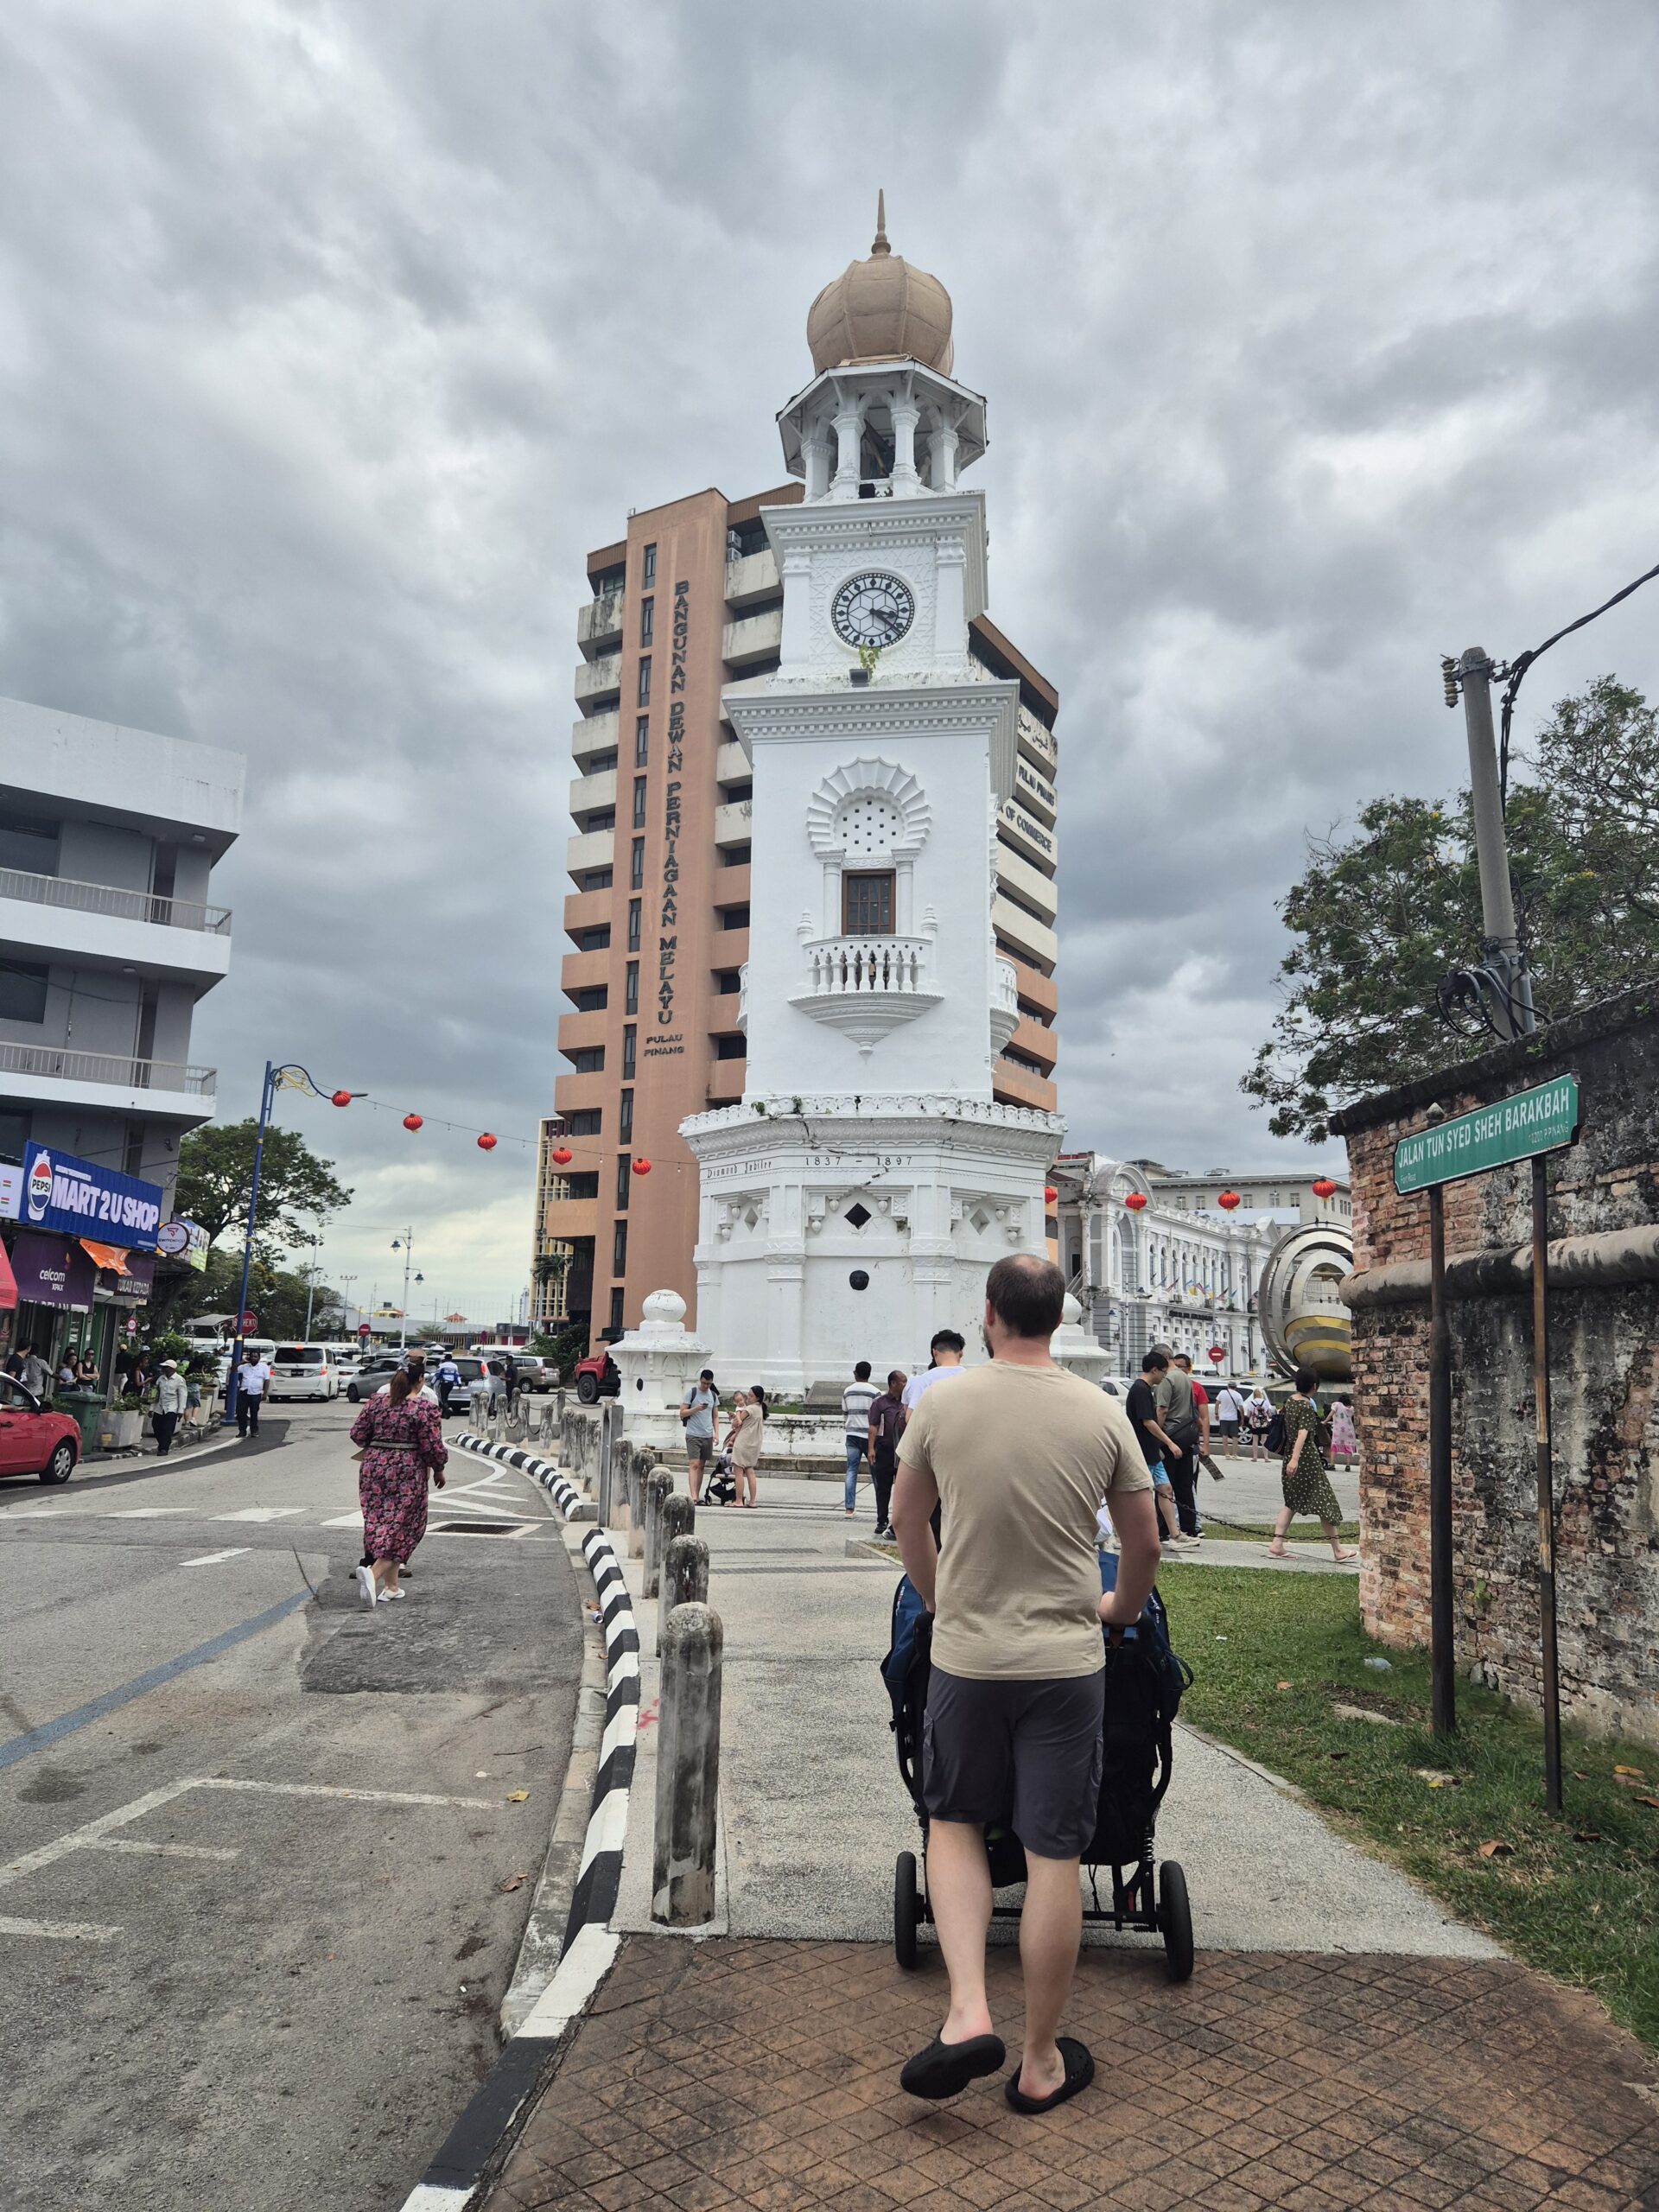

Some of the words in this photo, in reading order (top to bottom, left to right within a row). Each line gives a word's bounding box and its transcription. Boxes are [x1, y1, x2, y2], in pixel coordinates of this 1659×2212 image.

[671, 580, 690, 694] BANGUNAN
[667, 701, 685, 773] DEWAN
[1019, 765, 1036, 790] PULAU
[1006, 805, 1016, 821] OF
[1017, 814, 1052, 853] COMMERCE
[661, 781, 681, 927] PERNIAGAAN
[658, 935, 677, 1025] MELAYU
[643, 1046, 685, 1057] PINANG
[645, 1033, 683, 1045] PULAU
[1398, 1141, 1425, 1168] JALAN
[1427, 1133, 1445, 1159] TUN
[1446, 1123, 1471, 1153] SYED
[1474, 1111, 1502, 1143] SHEH
[1505, 1086, 1569, 1132] BARAKBAH
[805, 1156, 841, 1166] 1837
[876, 1156, 912, 1166] 1897
[31, 1179, 51, 1192] PEPSI
[50, 1175, 101, 1217] MART
[122, 1197, 159, 1232] SHOP
[39, 1268, 66, 1282] celcom
[52, 1283, 64, 1292] XPAX
[233, 1318, 257, 1328] BHENTI
